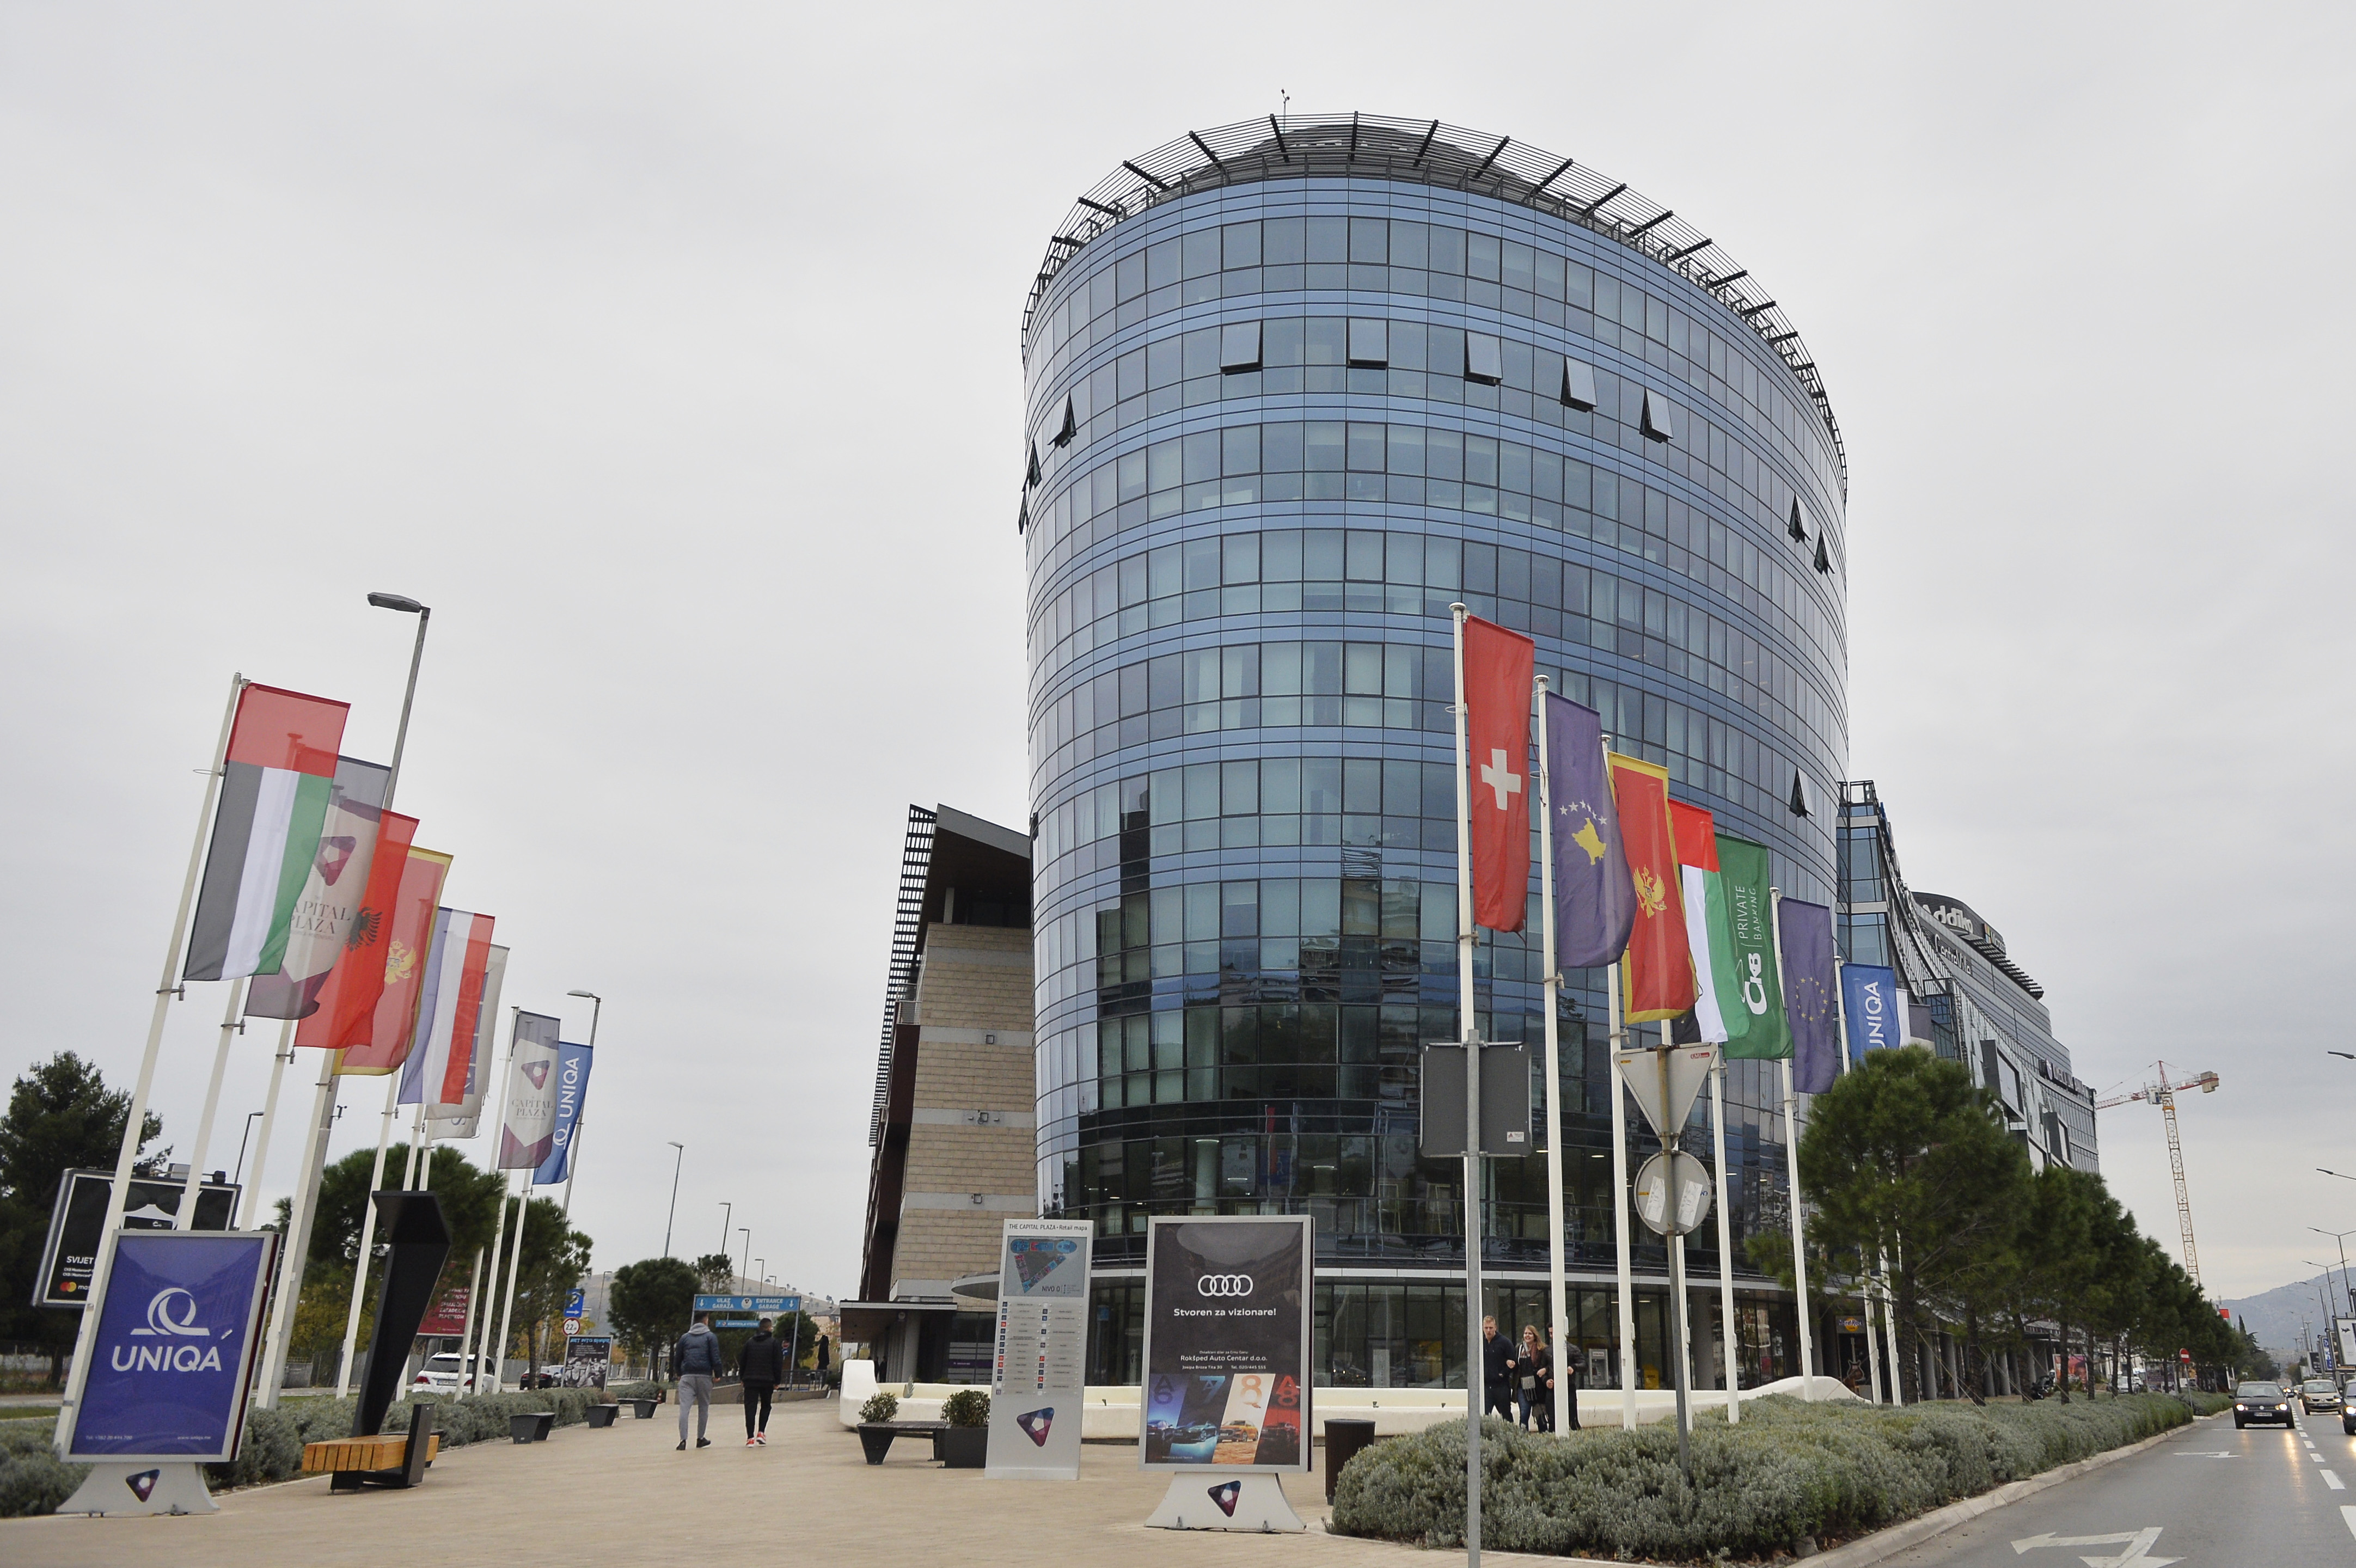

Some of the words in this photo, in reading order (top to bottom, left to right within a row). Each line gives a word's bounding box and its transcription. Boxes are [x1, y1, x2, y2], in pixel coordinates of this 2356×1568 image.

[295, 901, 351, 921] APITAL
[1735, 885, 1748, 939] PRIVATE
[1748, 887, 1762, 940] BANKING
[1745, 953, 1767, 1015] CKB
[559, 1057, 579, 1118] UNIQA
[512, 1099, 553, 1108] CAPITAL
[517, 1108, 546, 1116] PLAZA
[66, 1256, 94, 1264] SVIJET
[1173, 1308, 1212, 1316] Stvoren
[1228, 1308, 1276, 1316] vizionare!
[112, 1345, 222, 1372] UNIQA
